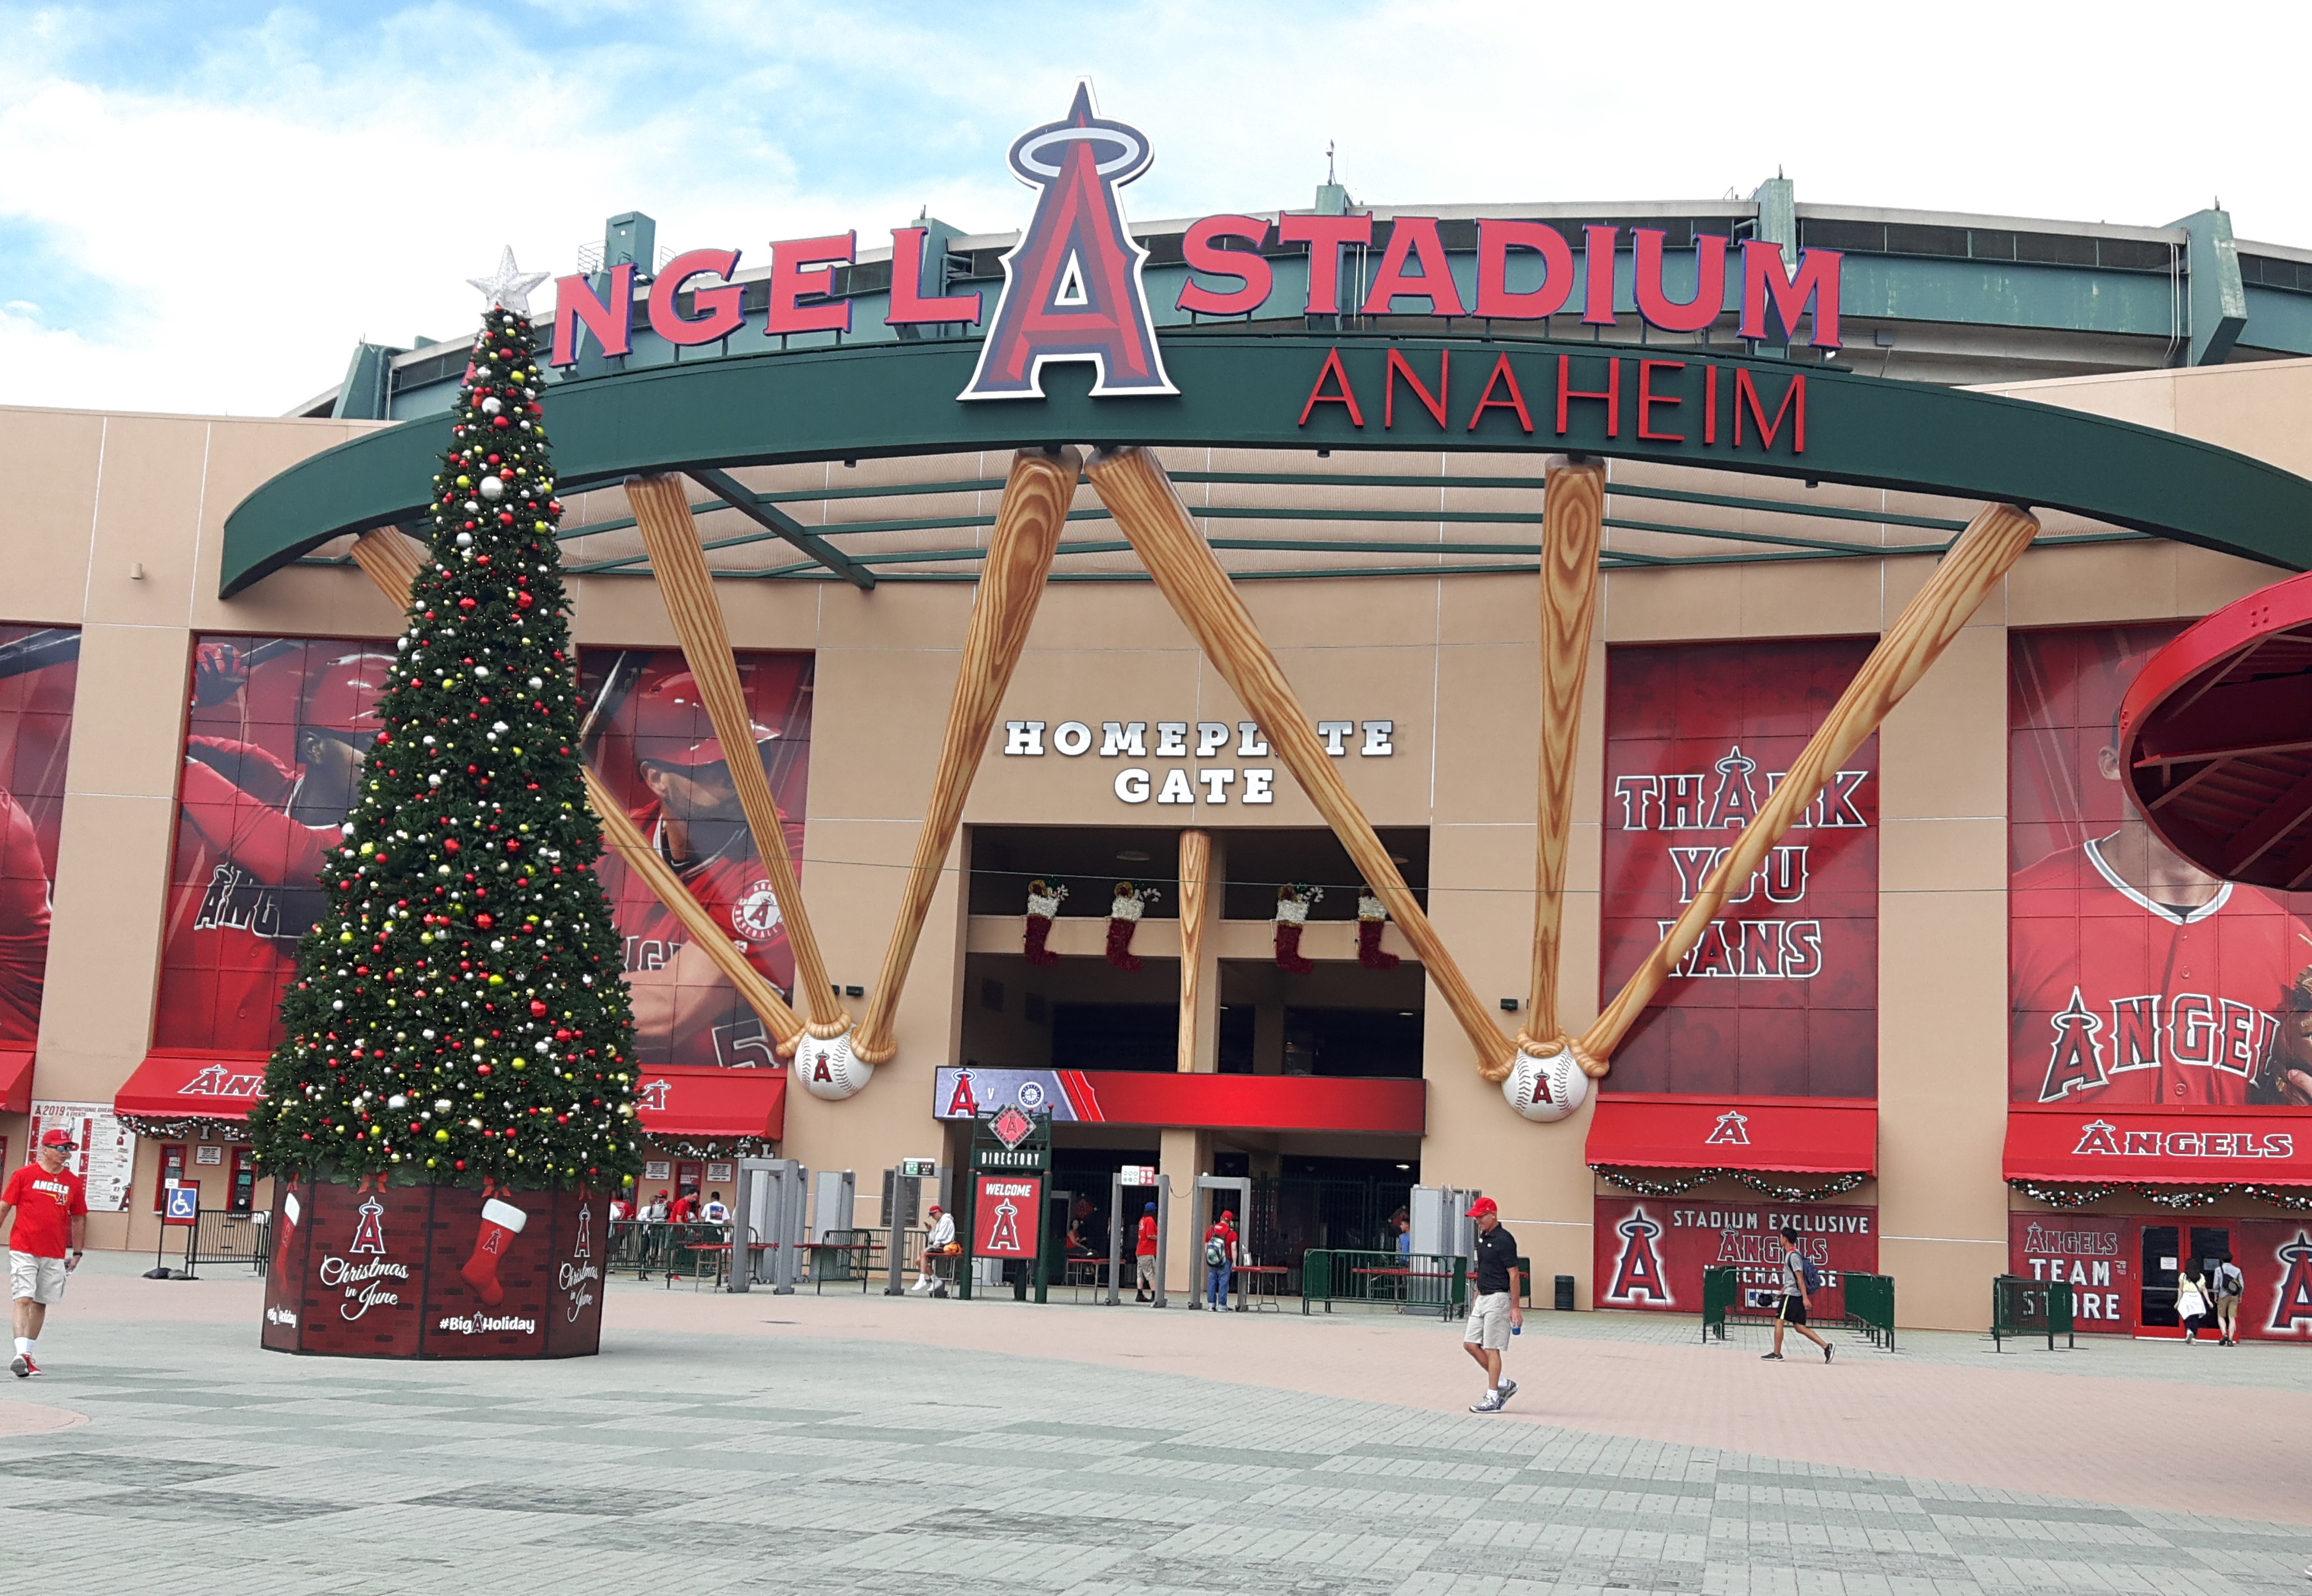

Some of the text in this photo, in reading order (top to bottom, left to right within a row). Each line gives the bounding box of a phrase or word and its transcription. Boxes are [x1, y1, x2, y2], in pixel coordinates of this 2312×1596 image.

[955, 75, 1180, 402] A
[548, 210, 1845, 368] NGEL STADIUM
[1298, 346, 1805, 454] ANAHEIM
[1004, 720, 1393, 757] HOMEPLTE
[1114, 768, 1274, 804] GATE
[813, 1049, 833, 1082] A
[945, 1068, 976, 1118] A
[1531, 1069, 1553, 1104] A
[43, 1105, 65, 1116] 2019
[1705, 1111, 1750, 1144] A
[2072, 1120, 2293, 1158] ANGELS
[982, 1152, 1039, 1166] DIRECTORY
[32, 1180, 69, 1194] ANGELS
[986, 1183, 1031, 1197] WELCOME
[349, 1196, 386, 1254] A
[574, 1203, 590, 1257] A
[987, 1198, 1020, 1250] A
[1673, 1210, 1869, 1234] STADIUM EXCLUSIVE
[2024, 1222, 2118, 1255] ANGELS
[1606, 1206, 1673, 1302] A
[1717, 1224, 1829, 1265] ANGLS
[320, 1255, 409, 1285] Christmas
[559, 1260, 598, 1290] Christmas
[2028, 1259, 2110, 1286] TEAM
[341, 1280, 398, 1321] in June
[568, 1283, 592, 1322] June
